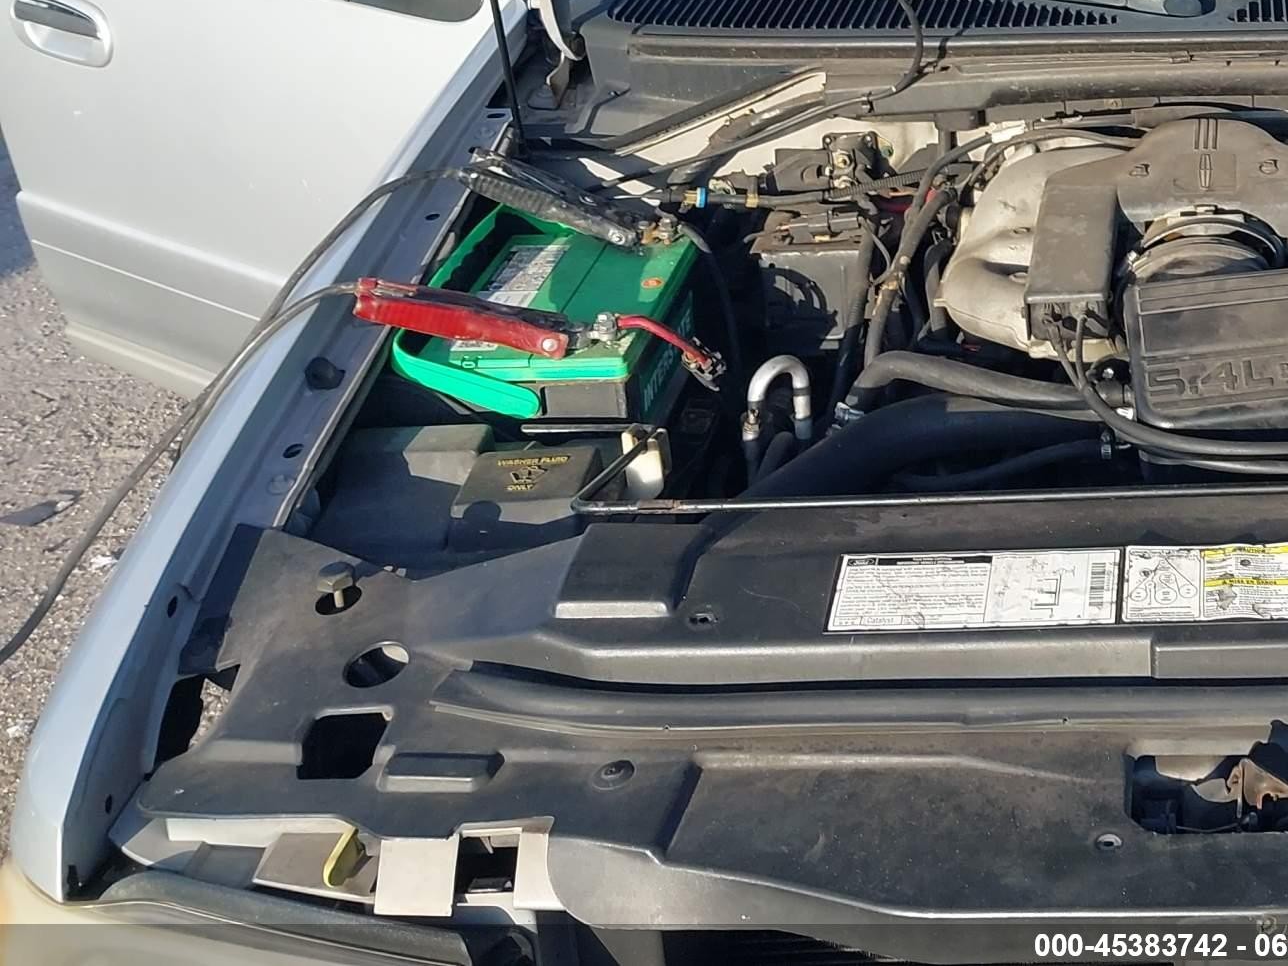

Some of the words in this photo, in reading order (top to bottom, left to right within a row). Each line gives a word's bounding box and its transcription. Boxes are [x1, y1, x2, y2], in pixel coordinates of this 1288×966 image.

[643, 308, 692, 412] INTERSTE
[1147, 359, 1274, 397] 5.4L
[496, 457, 540, 467] WASHER
[540, 454, 569, 465] FLUID
[506, 483, 535, 491] ONLY
